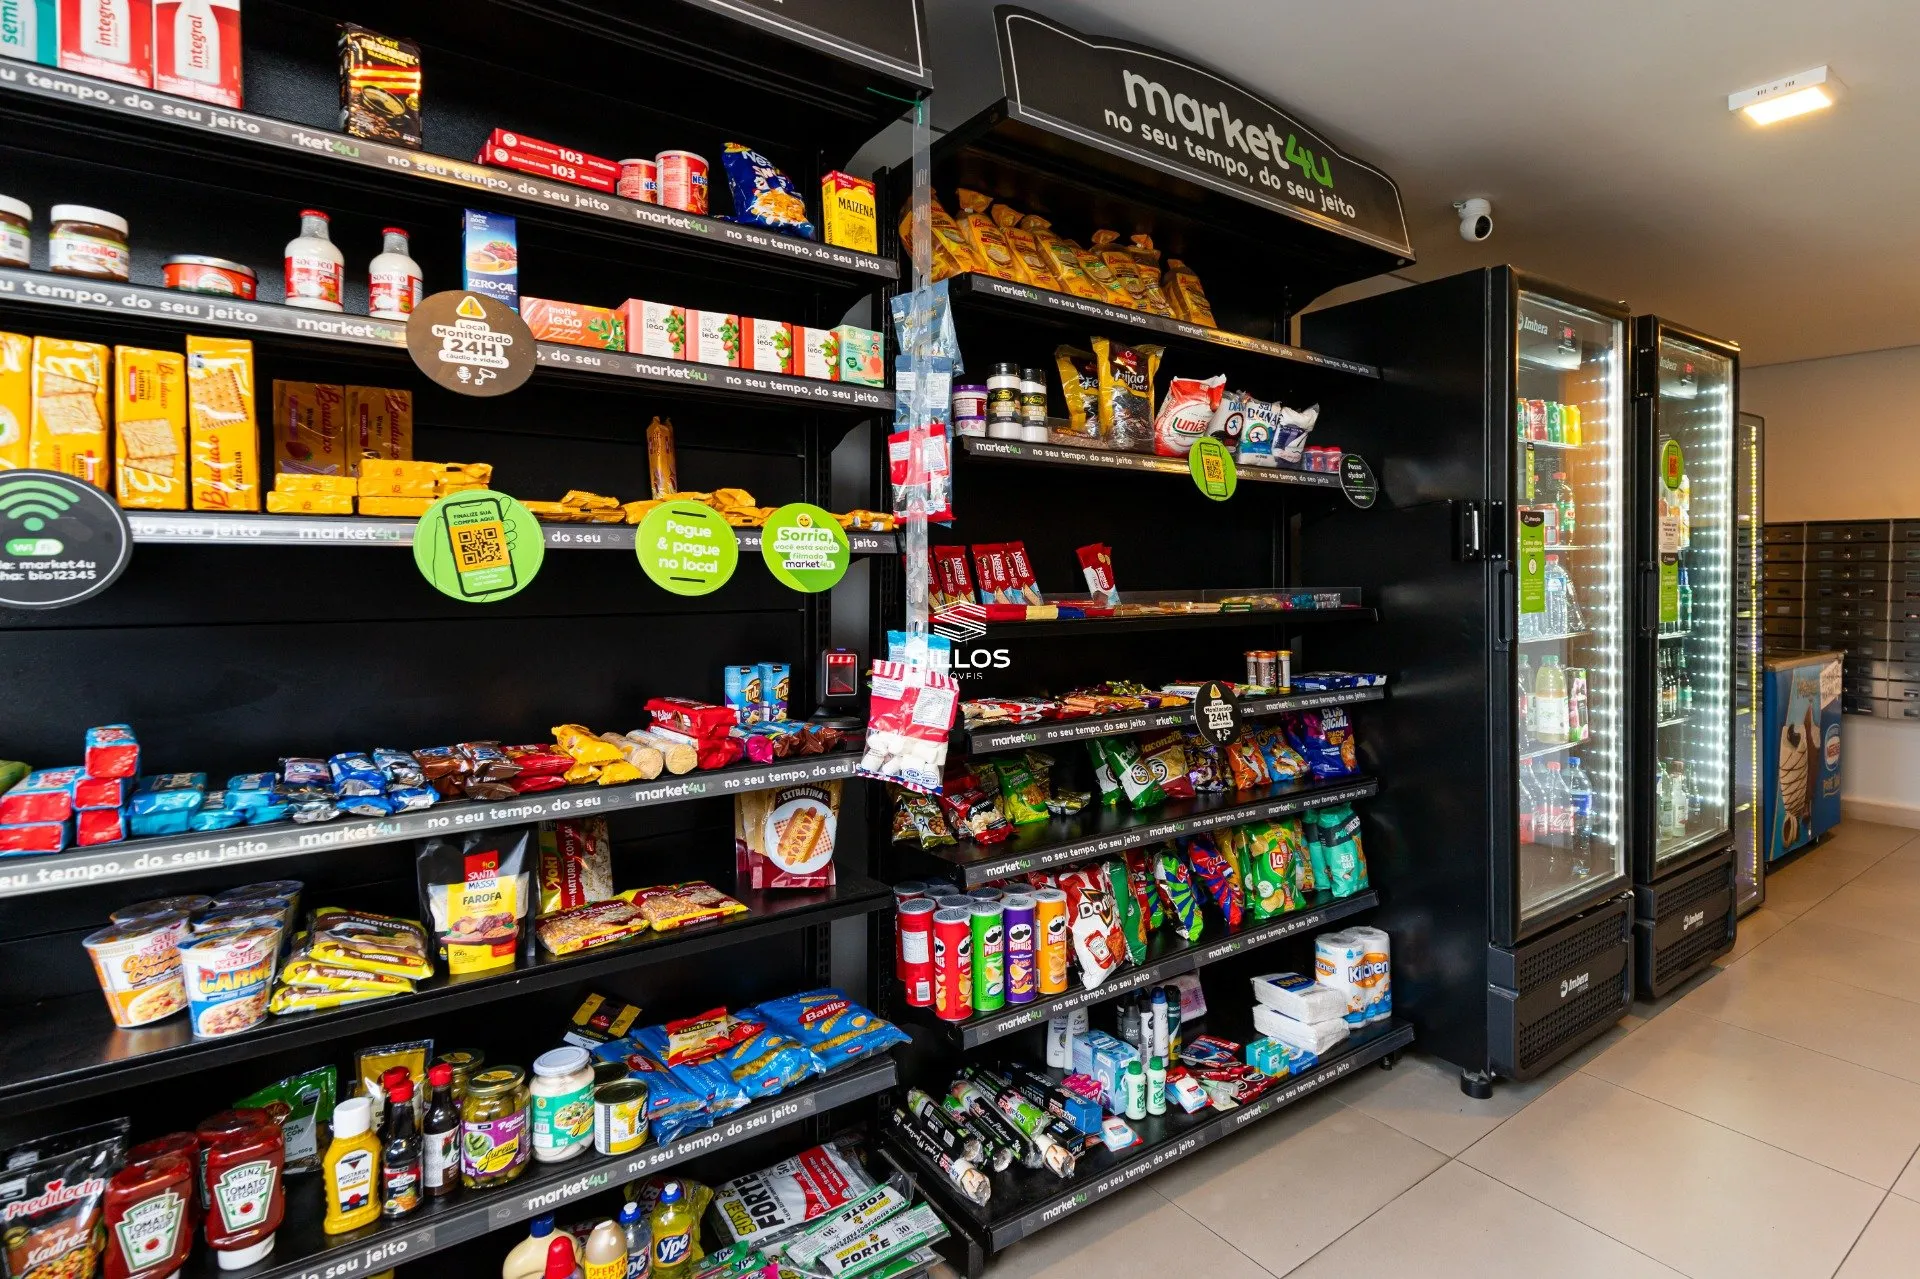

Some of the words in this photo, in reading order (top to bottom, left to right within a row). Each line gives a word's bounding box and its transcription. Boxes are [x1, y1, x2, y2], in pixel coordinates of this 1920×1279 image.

[189, 15, 207, 69] integral
[25, 71, 116, 105] tempo,
[124, 92, 155, 111] do
[162, 103, 202, 121] seu
[208, 111, 260, 134] jeito
[1123, 69, 1334, 189] market4u
[558, 148, 584, 165] 103
[1105, 109, 1133, 133] no
[1141, 122, 1178, 151] seu
[1184, 137, 1254, 183] tempo,
[1260, 166, 1281, 190] do
[1287, 181, 1315, 203] seu
[1320, 188, 1356, 219] jeito
[550, 163, 577, 180] 103
[838, 197, 876, 220] MAIZENA
[636, 208, 709, 233] market4u
[66, 243, 117, 259] nutella
[23, 280, 114, 306] tempo,
[122, 293, 152, 309] do
[161, 300, 200, 315] seu
[206, 304, 258, 322] jeito
[296, 318, 393, 340] market4u
[459, 323, 486, 332] Local
[547, 313, 583, 329] leão
[646, 322, 664, 331] leão
[1524, 315, 1548, 336] Imbera
[436, 327, 512, 345] Monitorado
[701, 331, 719, 340] leão
[756, 338, 774, 347] leão
[450, 339, 497, 358] 24H
[806, 346, 822, 355] leão
[726, 374, 742, 385] no
[745, 378, 767, 389] seu
[769, 380, 812, 397] tempo,
[814, 385, 829, 396] do
[832, 389, 851, 400] seu
[854, 391, 879, 403] jeito
[976, 442, 1021, 455] market4u
[453, 512, 481, 520] FINALIZE
[453, 518, 479, 526] COMPRA
[299, 525, 400, 541] market4u
[551, 531, 571, 543] do
[575, 533, 601, 544] seu
[666, 520, 712, 539] Pegue
[780, 529, 833, 543] Sorria,
[656, 537, 668, 550] &
[672, 540, 721, 556] pague
[775, 543, 794, 551] você
[792, 552, 824, 560] filmado
[19, 560, 97, 570] market4u
[658, 556, 679, 569] no
[682, 557, 718, 573] local
[785, 560, 832, 569] market4u
[951, 557, 967, 586] Nestlé
[990, 553, 1006, 582] Nestlé
[1012, 551, 1030, 578] Nestlé
[28, 569, 97, 581] bio12345
[1266, 701, 1296, 711] market4u
[1211, 712, 1229, 722] 24H
[991, 732, 1036, 747] market4u
[724, 776, 739, 788] no
[744, 773, 765, 787] seu
[767, 767, 810, 783] tempo,
[812, 764, 827, 776] do
[829, 762, 849, 774] seu
[781, 787, 823, 800] EXTRAFINA
[299, 822, 401, 848] market4u
[565, 840, 575, 856] COM
[467, 870, 496, 881] SANTA
[467, 880, 496, 890] MASSA
[565, 857, 577, 894] NATURAL
[462, 891, 502, 905] FAROFA
[350, 916, 421, 935] TRADICIONAL
[361, 952, 399, 963] TRADICIONAL
[199, 960, 272, 994] CARNE
[1348, 960, 1390, 984] Kitchen
[805, 1000, 846, 1022] Barilla
[998, 1009, 1042, 1032] market4u
[679, 1020, 716, 1034] TEIXEIRA
[1277, 1094, 1285, 1103] no
[1286, 1089, 1297, 1099] seu
[1297, 1079, 1319, 1094] tempo,
[1317, 1073, 1326, 1081] do
[1326, 1067, 1337, 1078] seu
[1336, 1062, 1350, 1076] jeito
[628, 1159, 646, 1173] no
[651, 1150, 674, 1166] seu
[677, 1132, 724, 1156] tempo,
[726, 1123, 743, 1137] do
[746, 1115, 767, 1130] seu
[770, 1103, 798, 1124] jeito
[230, 1166, 261, 1182] HEINZ
[224, 1178, 267, 1197] TOMATO
[226, 1186, 264, 1202] KETCHUP
[6, 1178, 104, 1220] Predilecta
[732, 1172, 786, 1231] FORTE
[840, 1191, 887, 1222] FORTE
[1042, 1193, 1088, 1221] market4u
[134, 1202, 166, 1218] HEINZ
[722, 1201, 759, 1236] SUPER
[128, 1211, 175, 1235] TOMATO
[129, 1219, 173, 1240] KETCHUP
[27, 1230, 90, 1263] Xadrez
[840, 1238, 891, 1269] FORTE
[325, 1260, 359, 1277] seu
[363, 1240, 409, 1269] jeito
